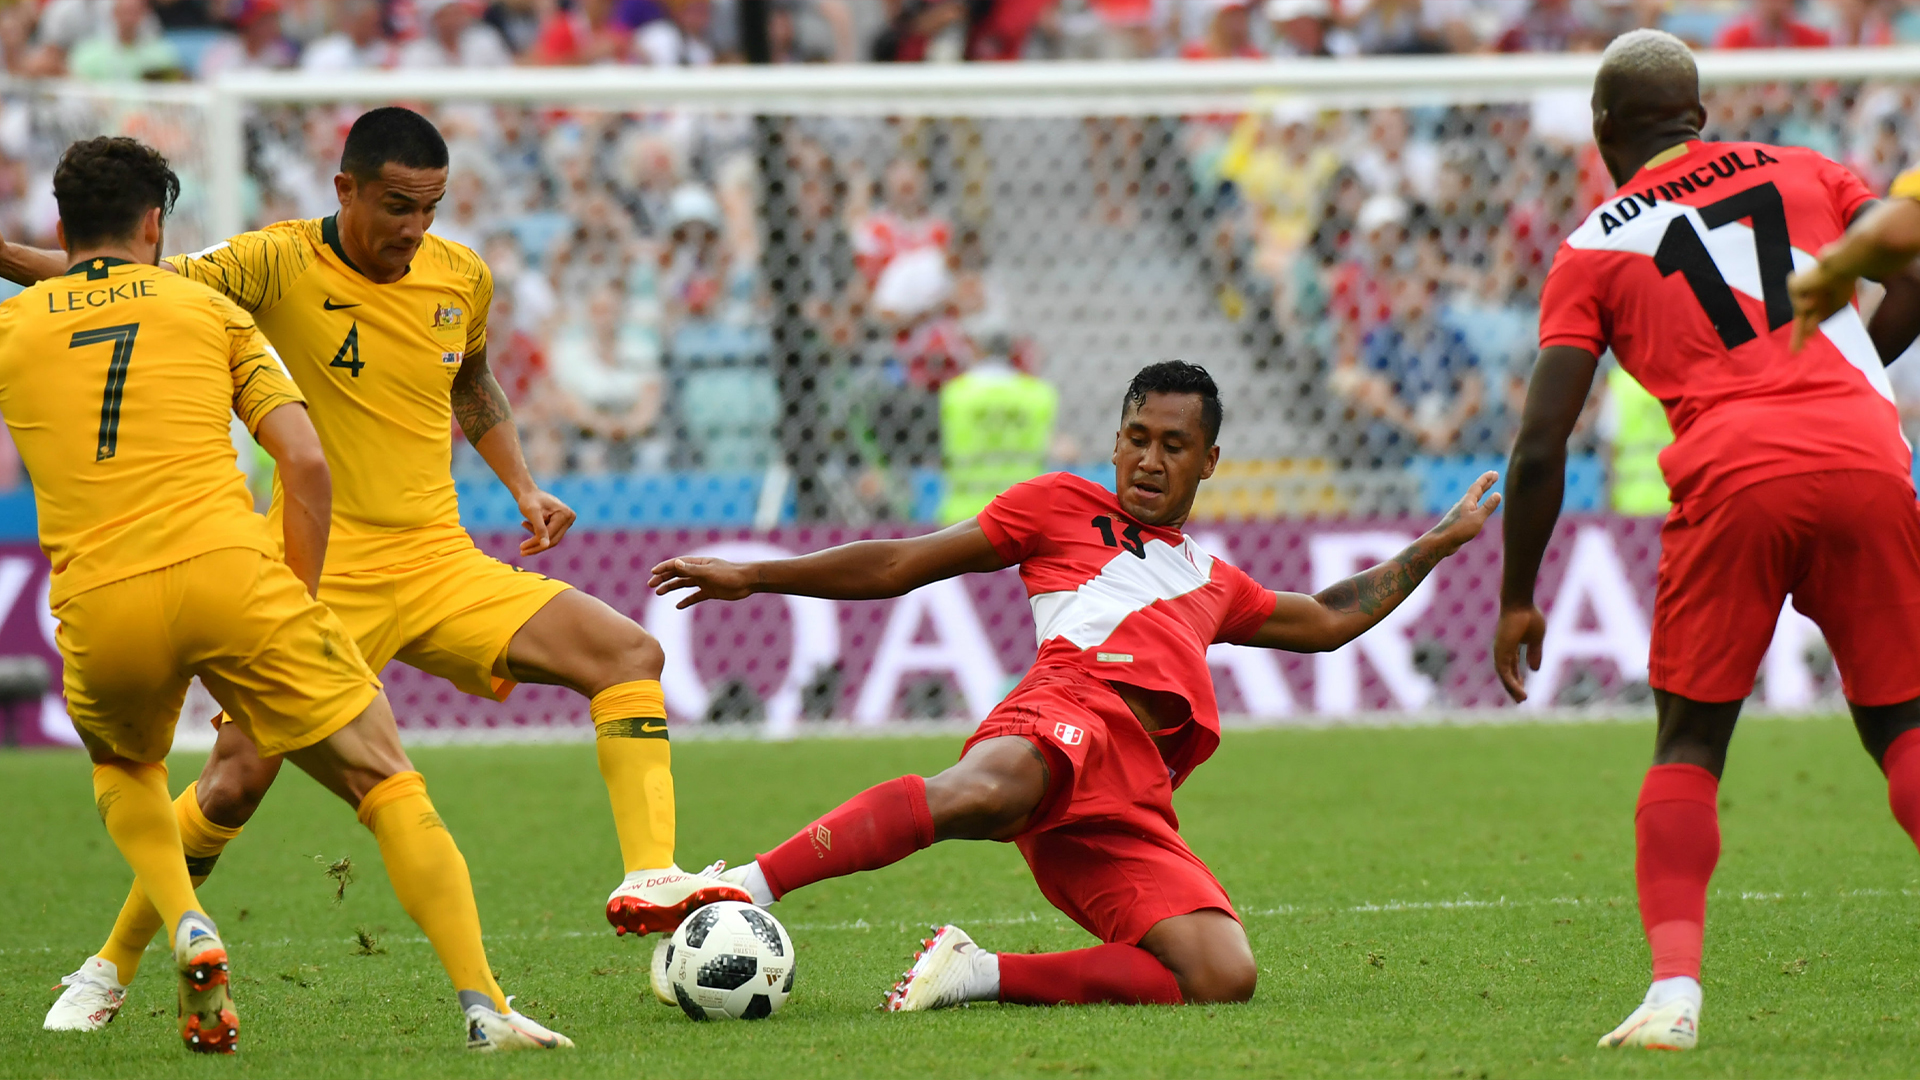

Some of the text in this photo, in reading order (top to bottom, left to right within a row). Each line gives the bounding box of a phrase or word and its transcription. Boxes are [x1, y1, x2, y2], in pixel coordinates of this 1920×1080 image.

[1600, 149, 1779, 236] ADVINCULA
[1654, 181, 1796, 350] 17
[48, 280, 158, 313] LECKIE
[330, 321, 365, 378] 4
[68, 322, 140, 462] 7
[1091, 515, 1147, 560] 13
[645, 534, 1450, 740] QAAR
[646, 875, 691, 888] balan
[762, 966, 784, 975] adidas
